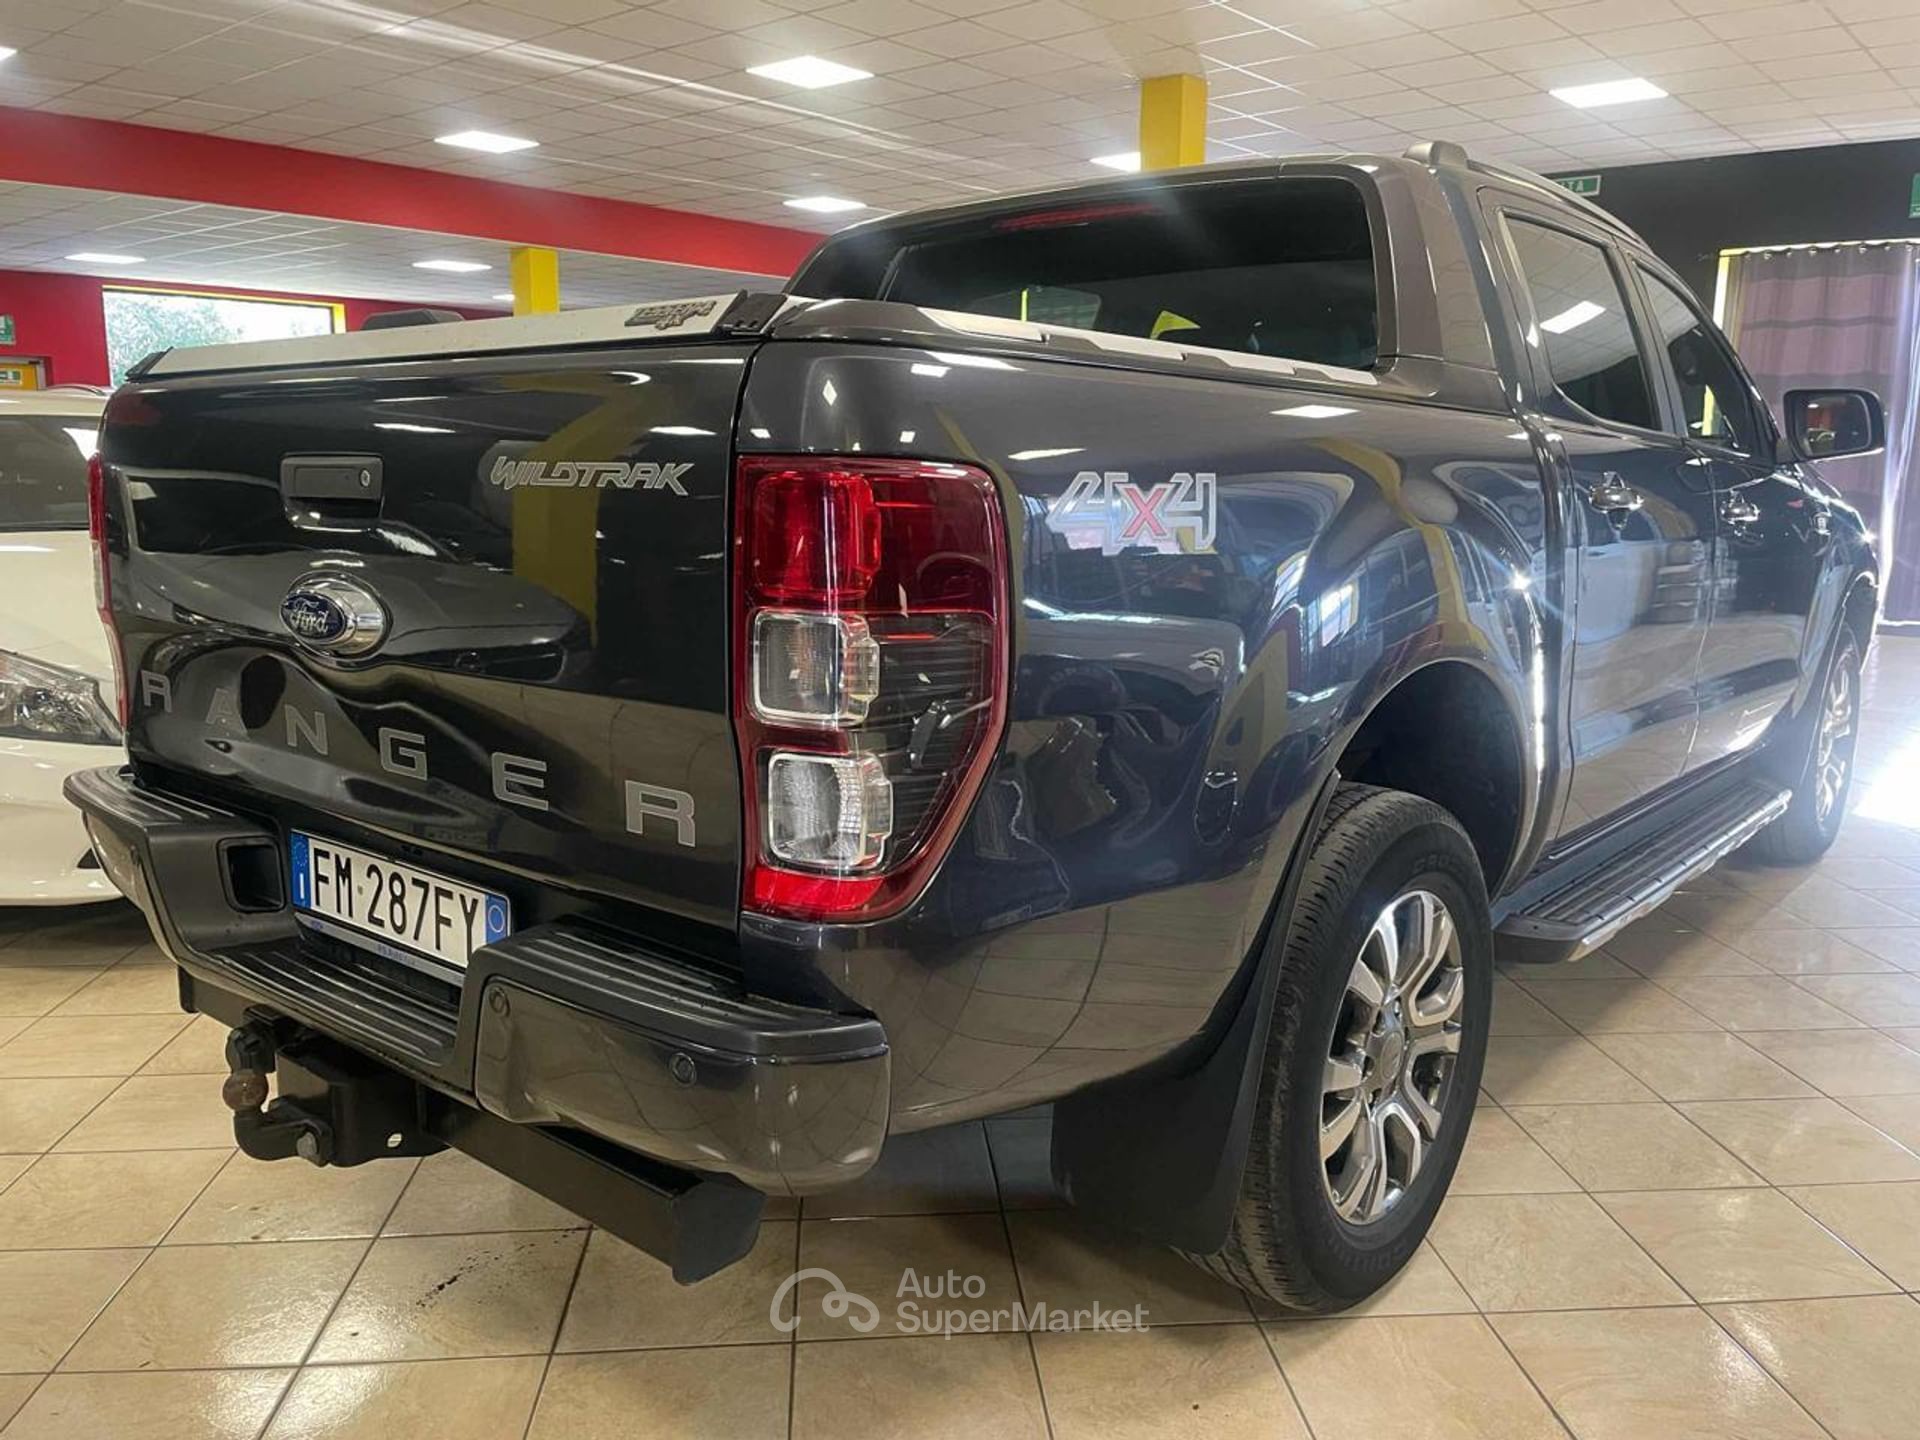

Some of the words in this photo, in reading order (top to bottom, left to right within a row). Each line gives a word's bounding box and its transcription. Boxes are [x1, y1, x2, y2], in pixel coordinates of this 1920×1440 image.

[490, 455, 695, 496] WILDTRAK
[290, 597, 330, 633] Ford
[141, 669, 696, 848] RANGER
[313, 847, 354, 919] FM
[366, 863, 479, 966] 287FY
